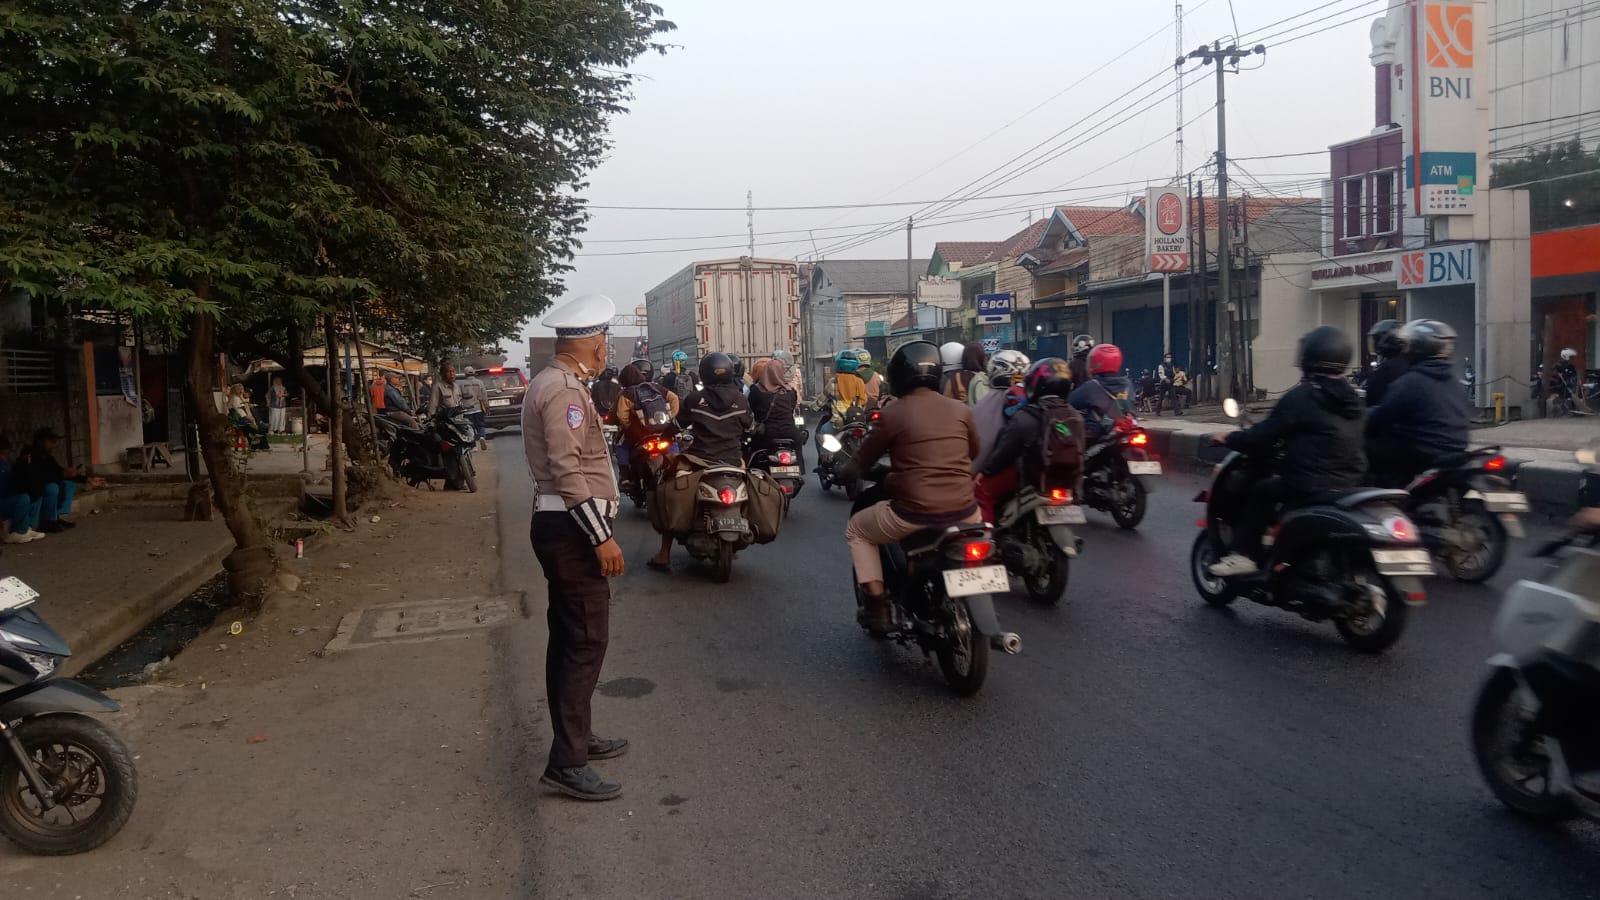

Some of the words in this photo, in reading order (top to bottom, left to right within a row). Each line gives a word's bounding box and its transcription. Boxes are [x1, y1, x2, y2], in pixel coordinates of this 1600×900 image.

[1429, 76, 1472, 99] BNI
[1430, 165, 1452, 176] ATM
[1154, 237, 1185, 245] HOLLAND
[1428, 248, 1473, 283] BNI
[989, 299, 1009, 309] BCA
